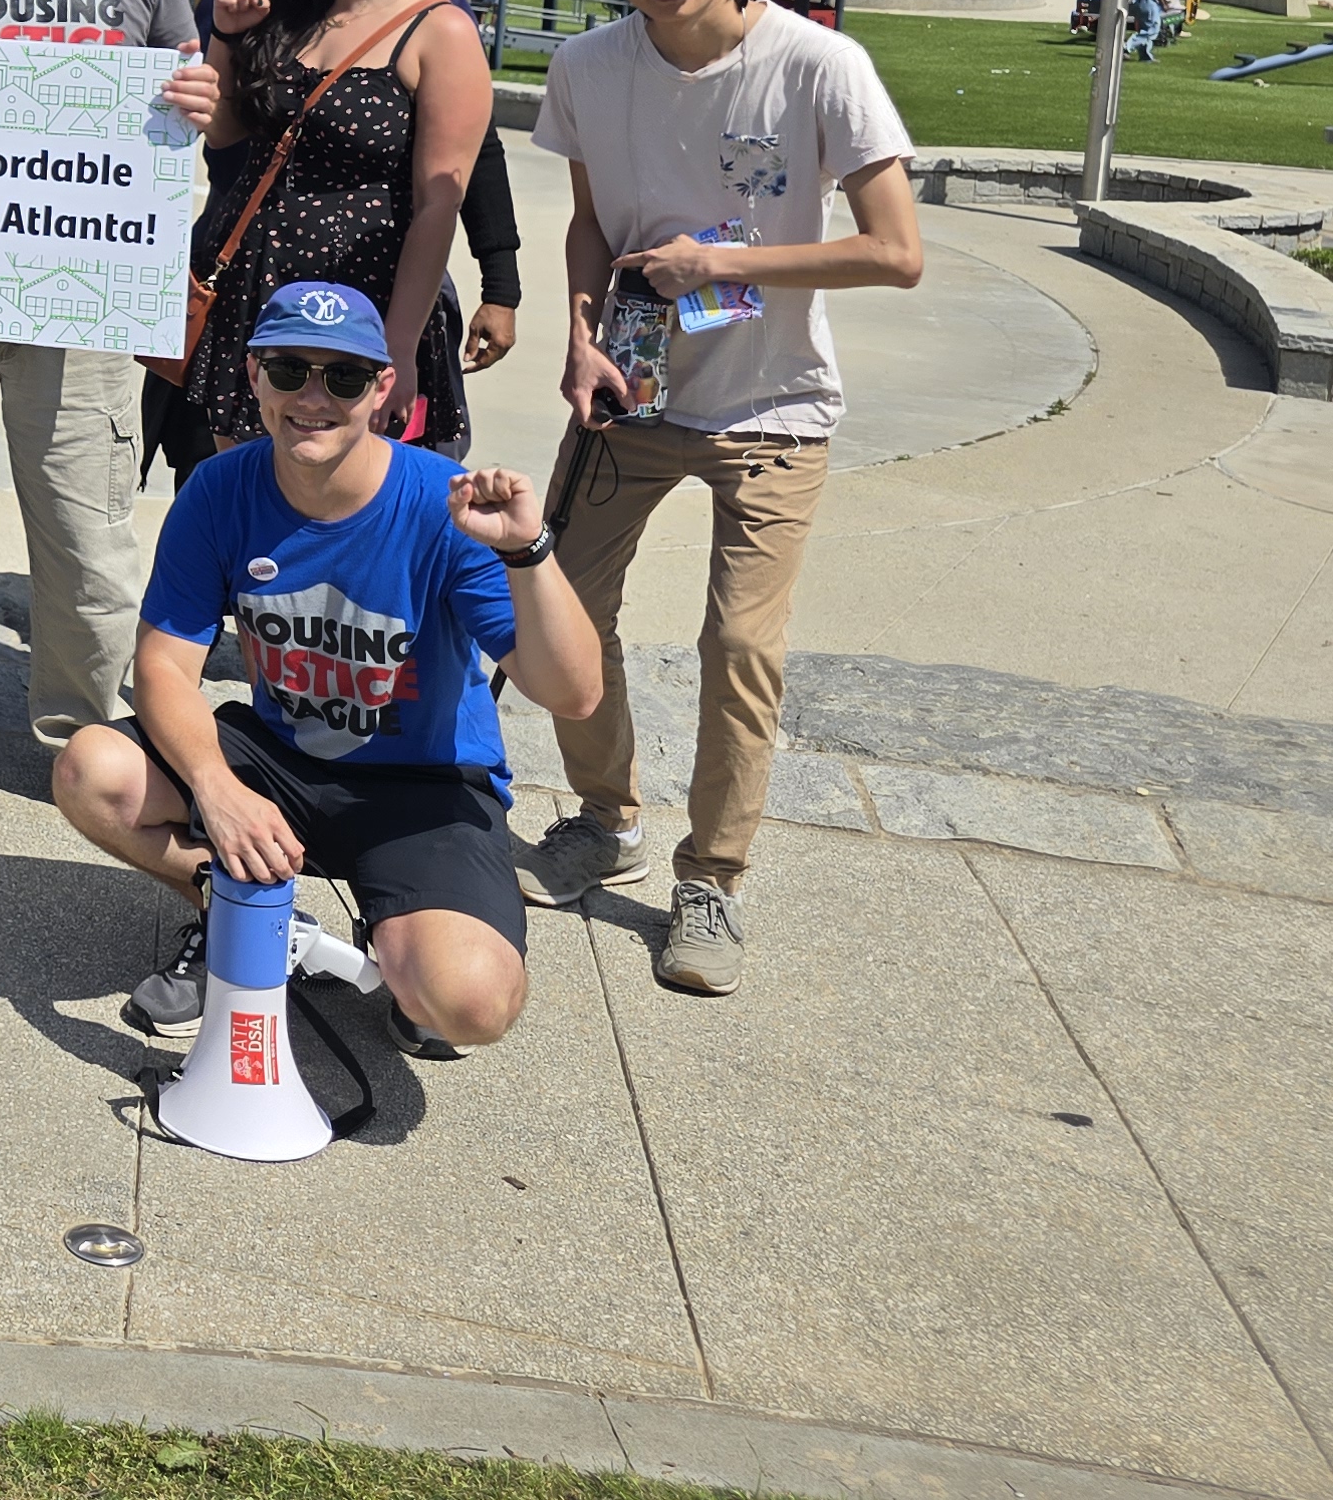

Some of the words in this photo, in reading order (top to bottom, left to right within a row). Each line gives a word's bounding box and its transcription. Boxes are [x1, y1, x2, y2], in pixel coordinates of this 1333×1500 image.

[0, 202, 157, 246] Atlanta!
[251, 635, 419, 706] USTICE
[233, 1018, 247, 1052] ATL
[248, 1019, 263, 1052] DSA
